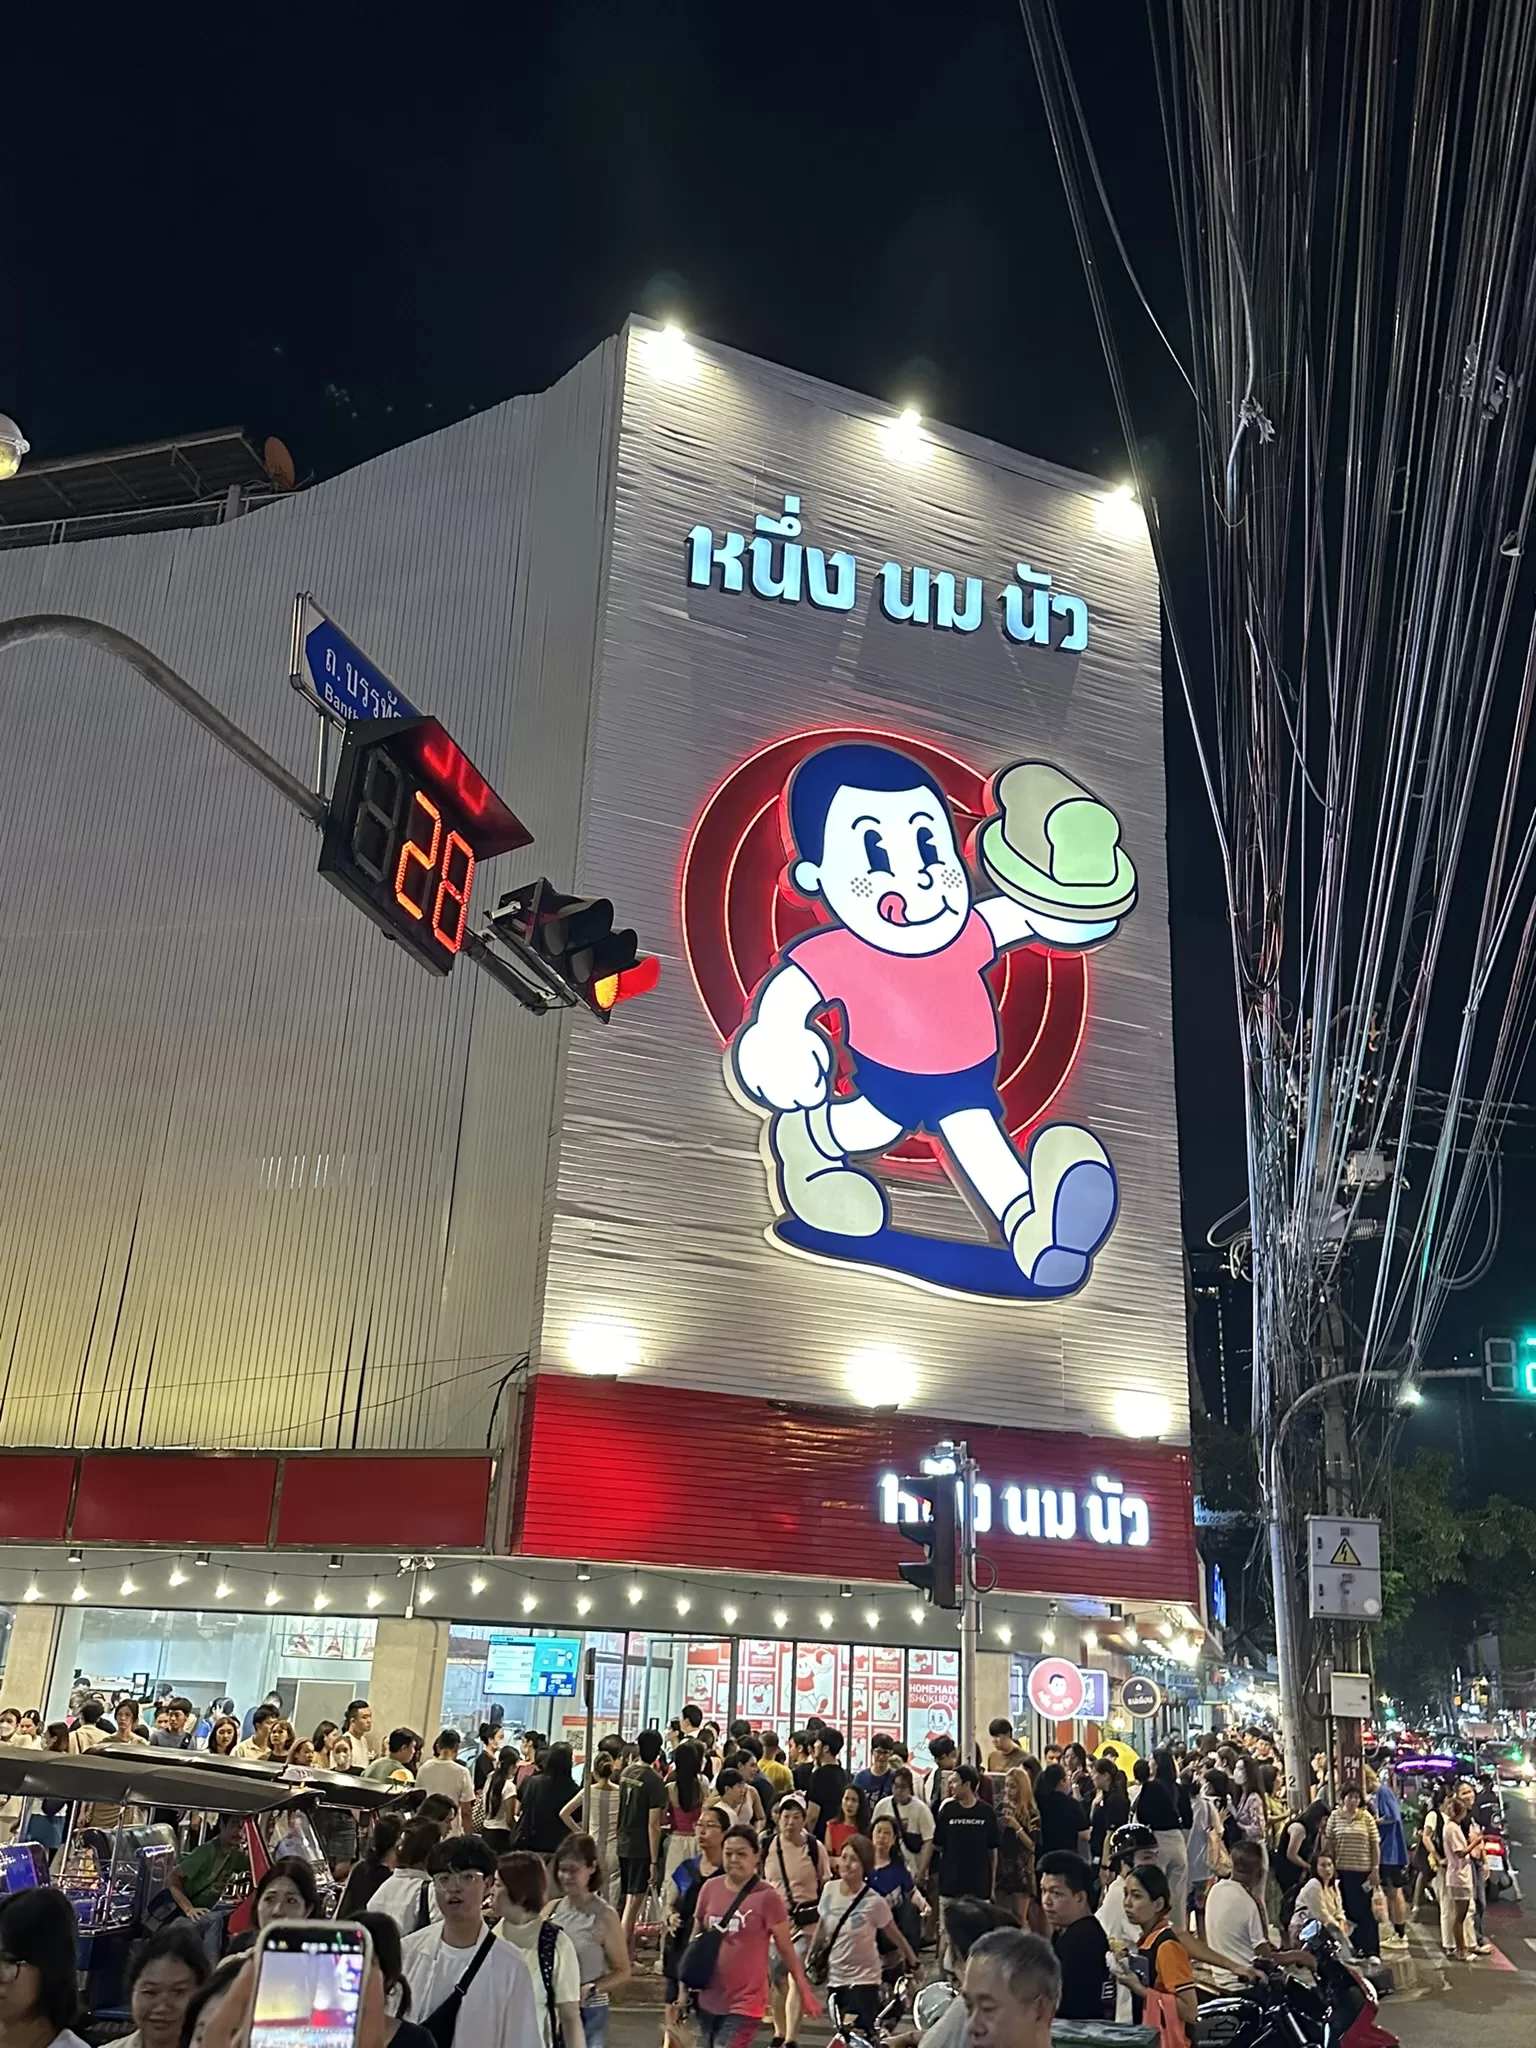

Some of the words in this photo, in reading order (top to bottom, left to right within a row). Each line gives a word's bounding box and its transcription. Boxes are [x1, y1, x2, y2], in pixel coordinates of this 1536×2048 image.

[685, 494, 857, 611] หนึ่ง
[876, 561, 985, 633] นม
[997, 562, 1091, 652] นัว
[1001, 1485, 1077, 1540] นม
[1082, 1475, 1152, 1547] นัว
[1344, 1756, 1360, 1769] PM
[1345, 1767, 1357, 1779] 11
[1288, 1775, 1296, 1788] 2
